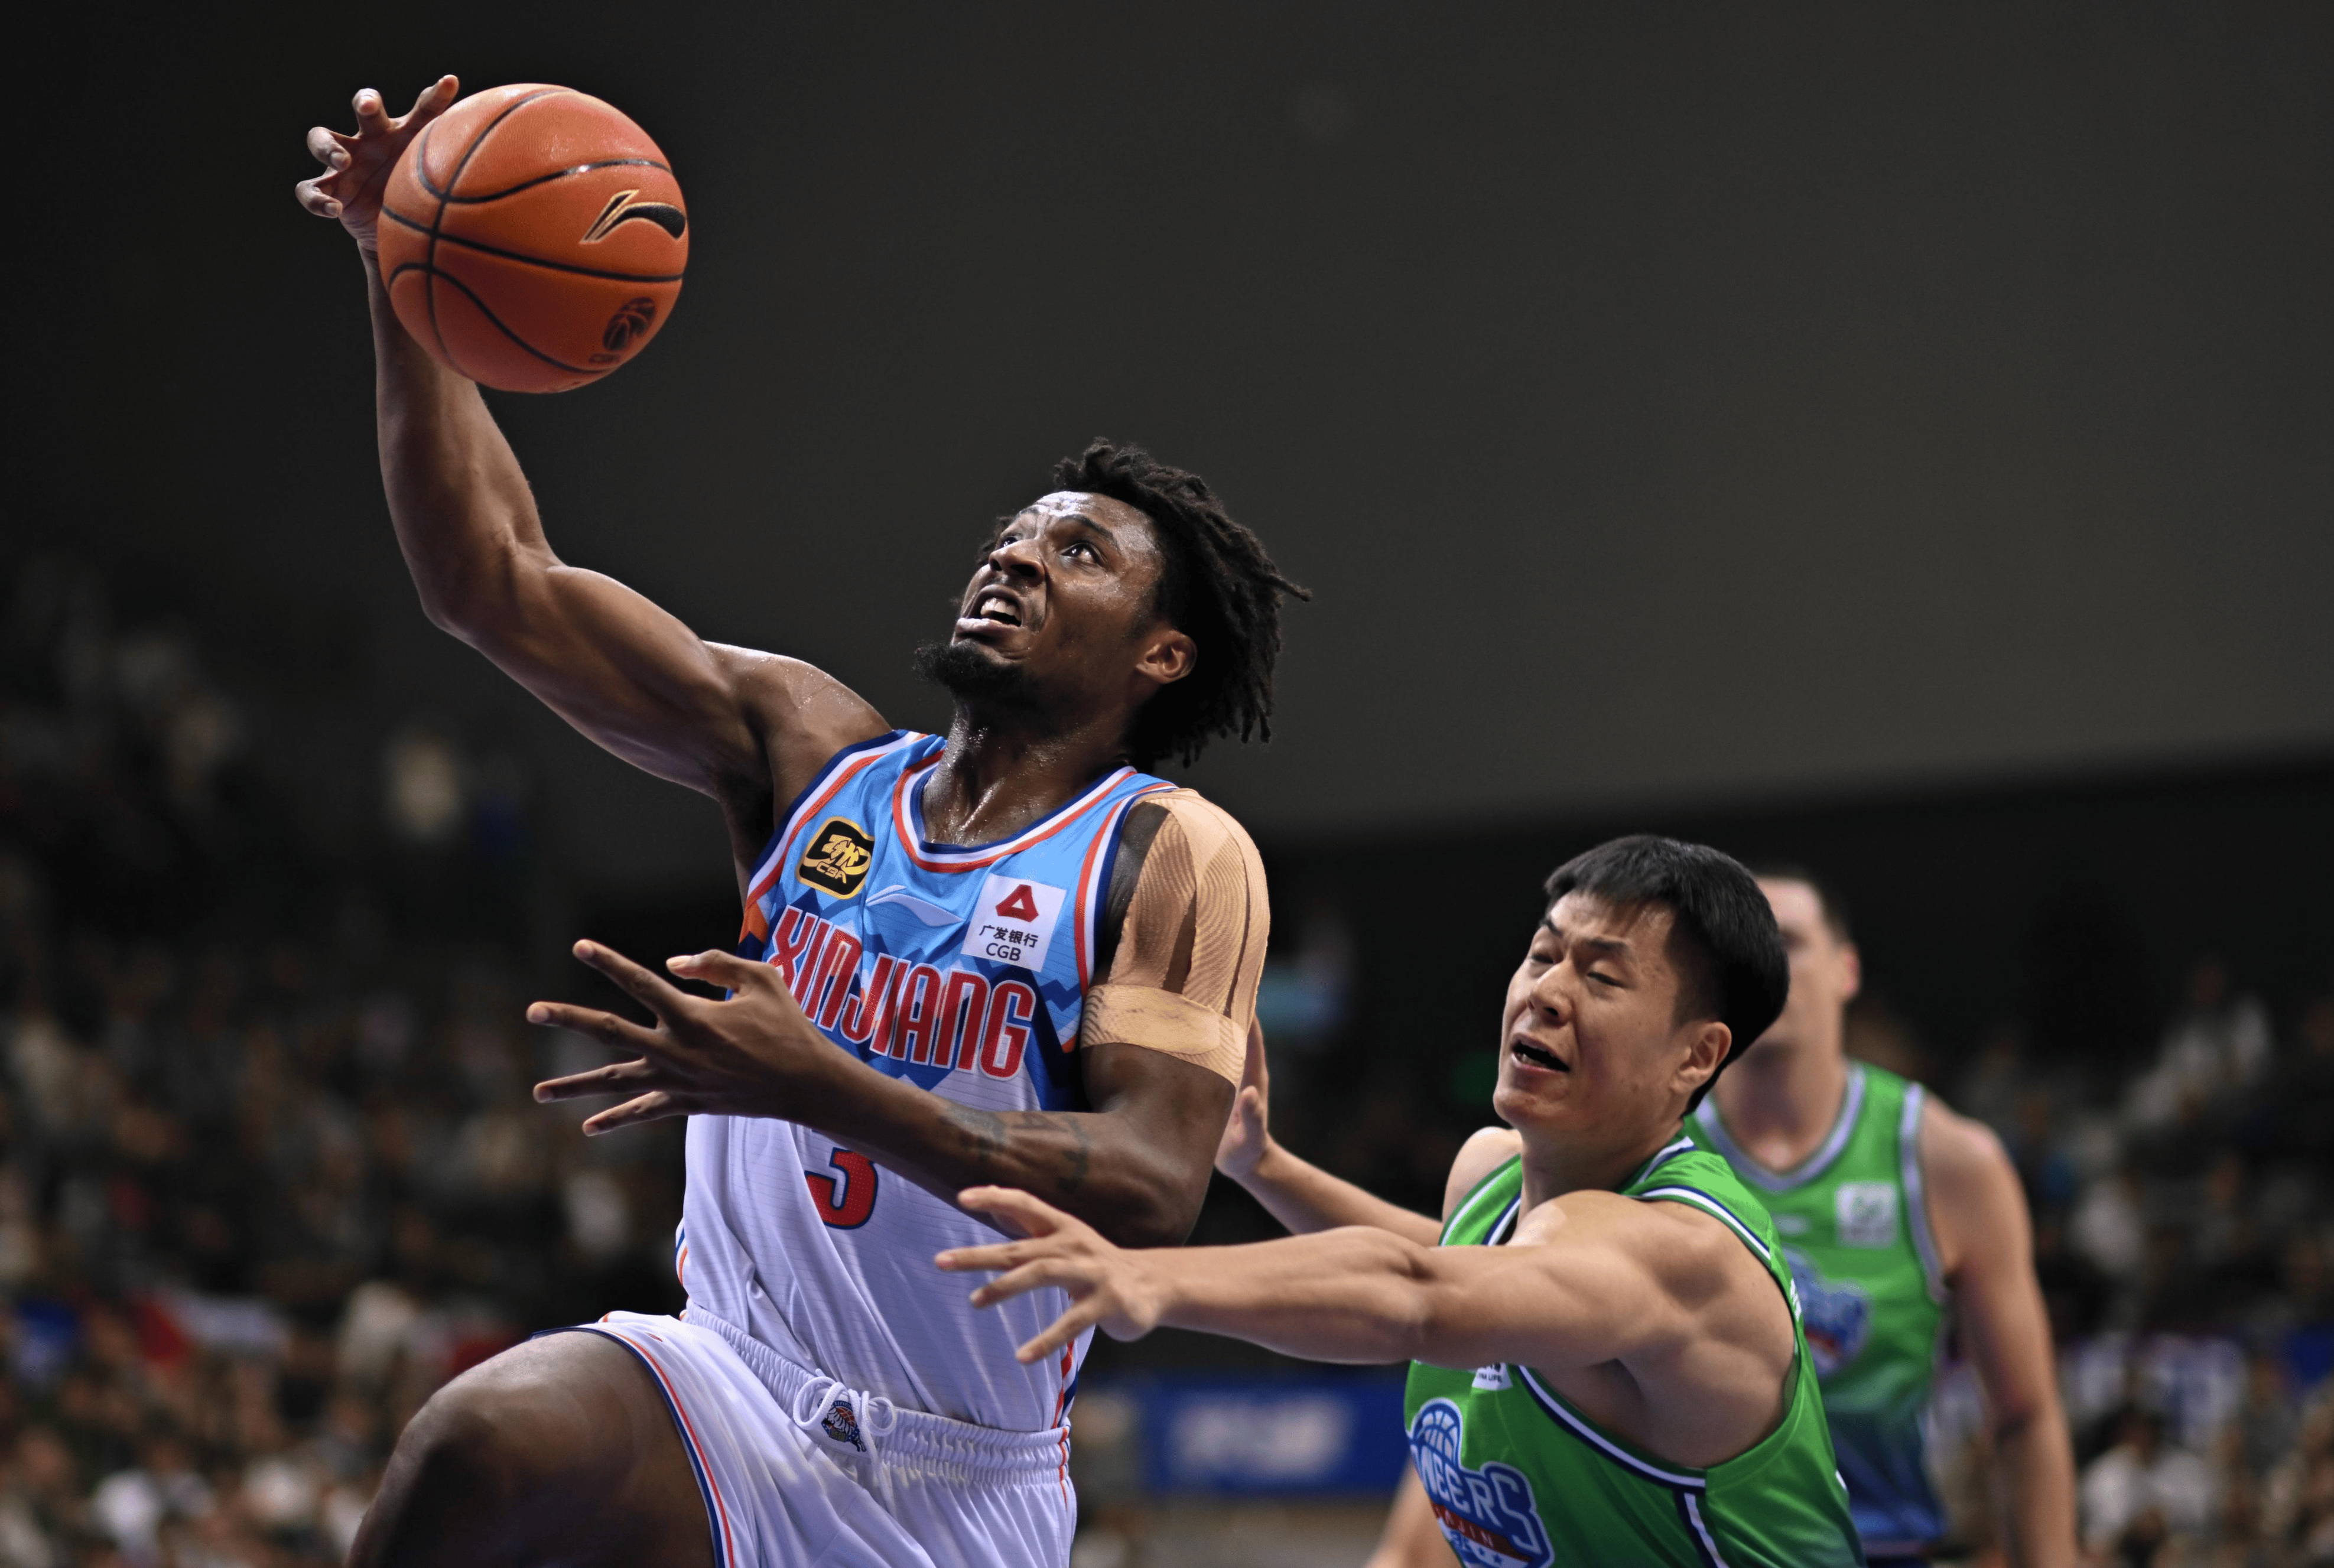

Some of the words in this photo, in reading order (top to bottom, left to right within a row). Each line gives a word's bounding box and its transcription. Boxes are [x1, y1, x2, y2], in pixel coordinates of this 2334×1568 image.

[816, 861, 847, 884] CBA
[979, 925, 1039, 948] 广发银行
[986, 942, 1022, 961] CGB
[766, 904, 1036, 1081] XINJIANG
[1410, 1444, 1543, 1555] NEERS
